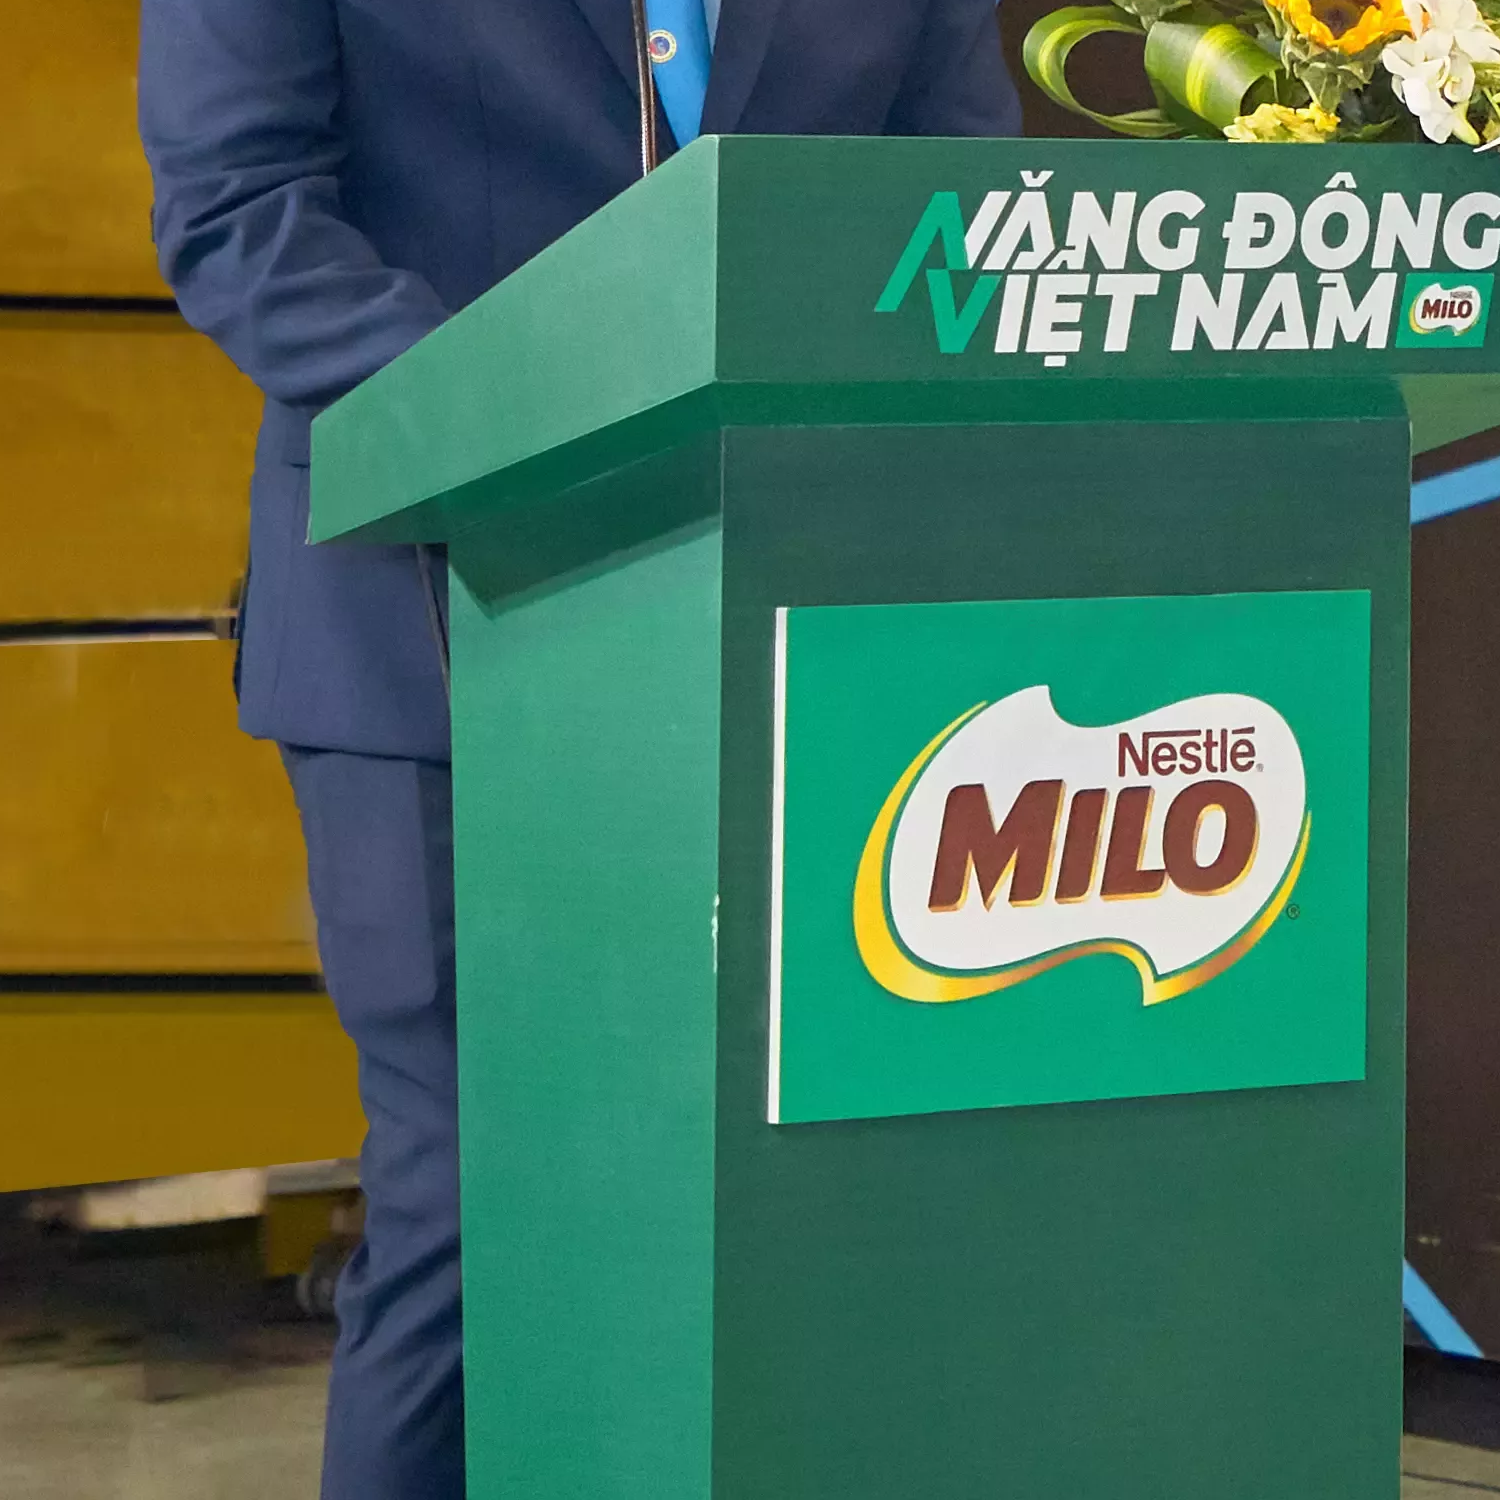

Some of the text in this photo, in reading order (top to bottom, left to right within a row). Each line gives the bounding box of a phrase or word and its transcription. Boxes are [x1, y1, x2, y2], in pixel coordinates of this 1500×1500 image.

[874, 171, 1206, 312] NĂNG
[926, 268, 1398, 367] VIỆT NAM
[1421, 298, 1473, 319] MILO
[1118, 726, 1256, 777] Nestlé
[928, 779, 1260, 912] MILO
